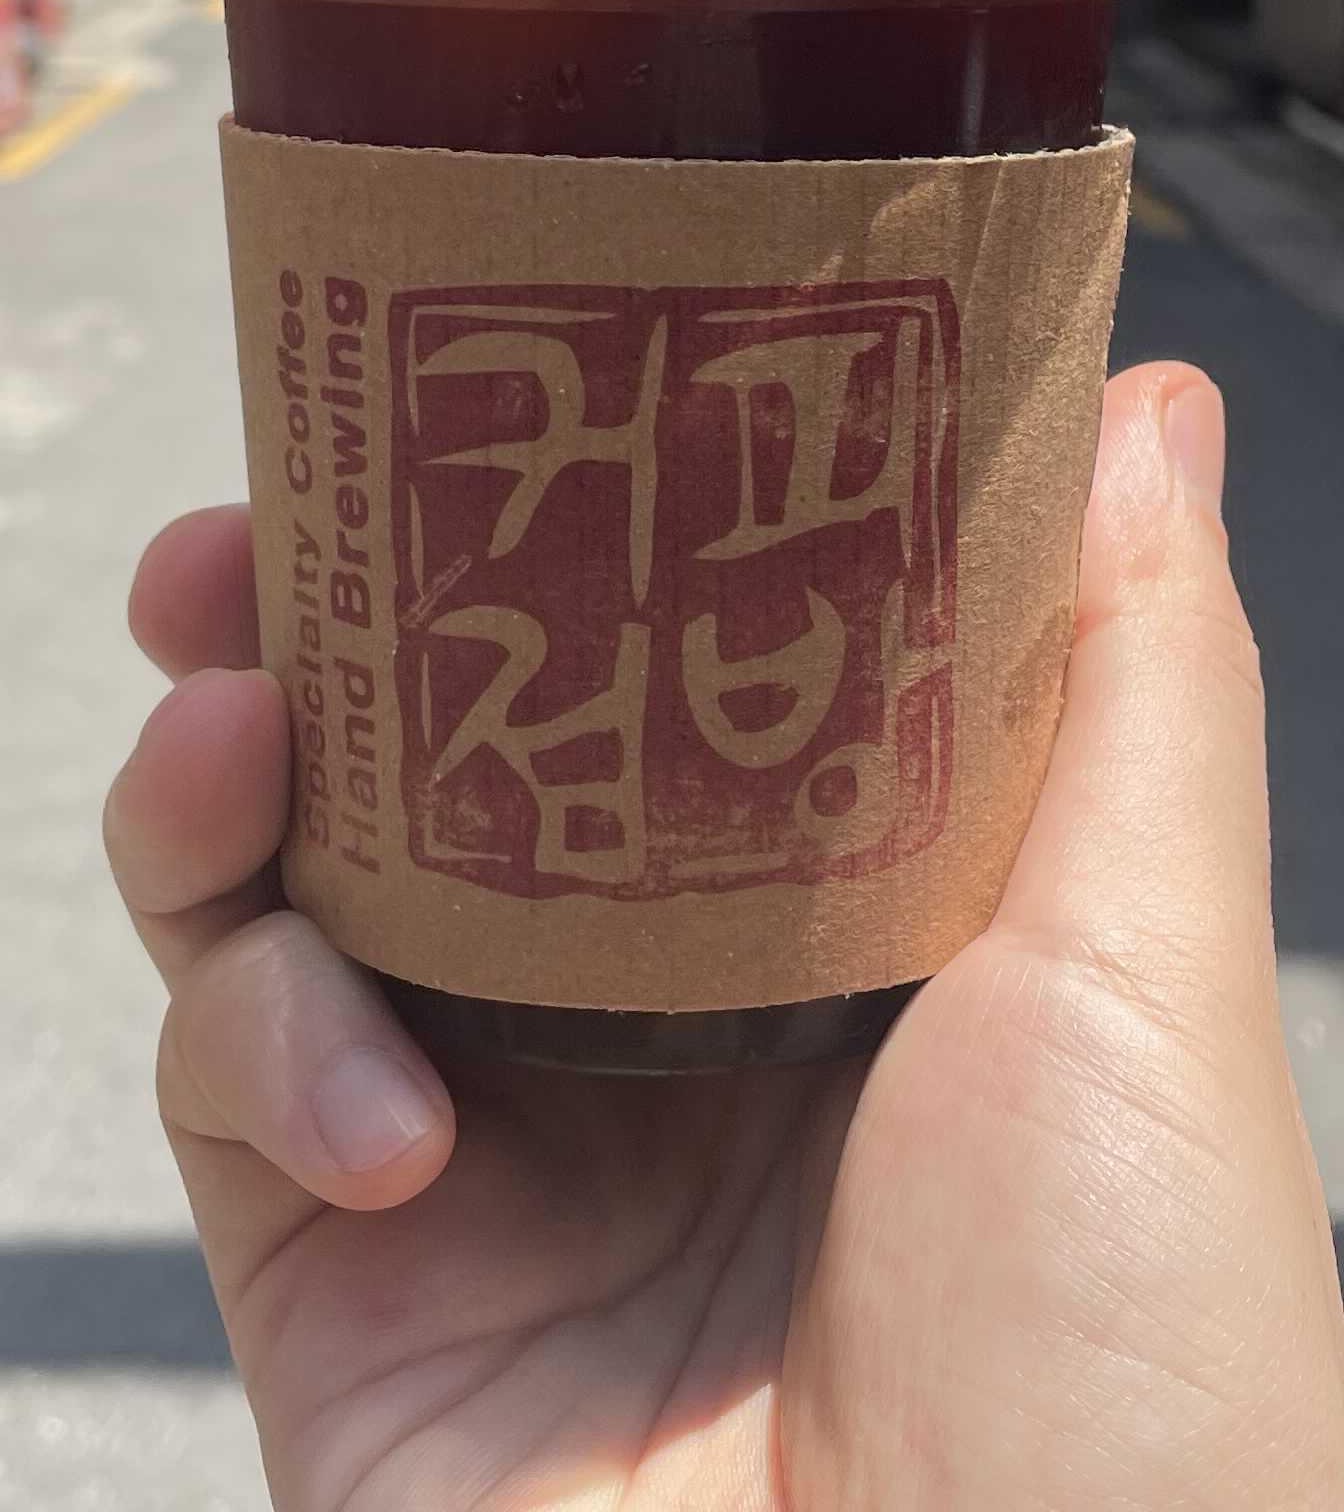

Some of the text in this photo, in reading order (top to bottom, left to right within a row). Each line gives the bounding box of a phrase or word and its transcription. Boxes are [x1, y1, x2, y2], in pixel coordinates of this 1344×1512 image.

[277, 269, 330, 849] Specialty Coffee
[320, 276, 382, 875] Hand Brewing
[415, 313, 921, 610] 커피
